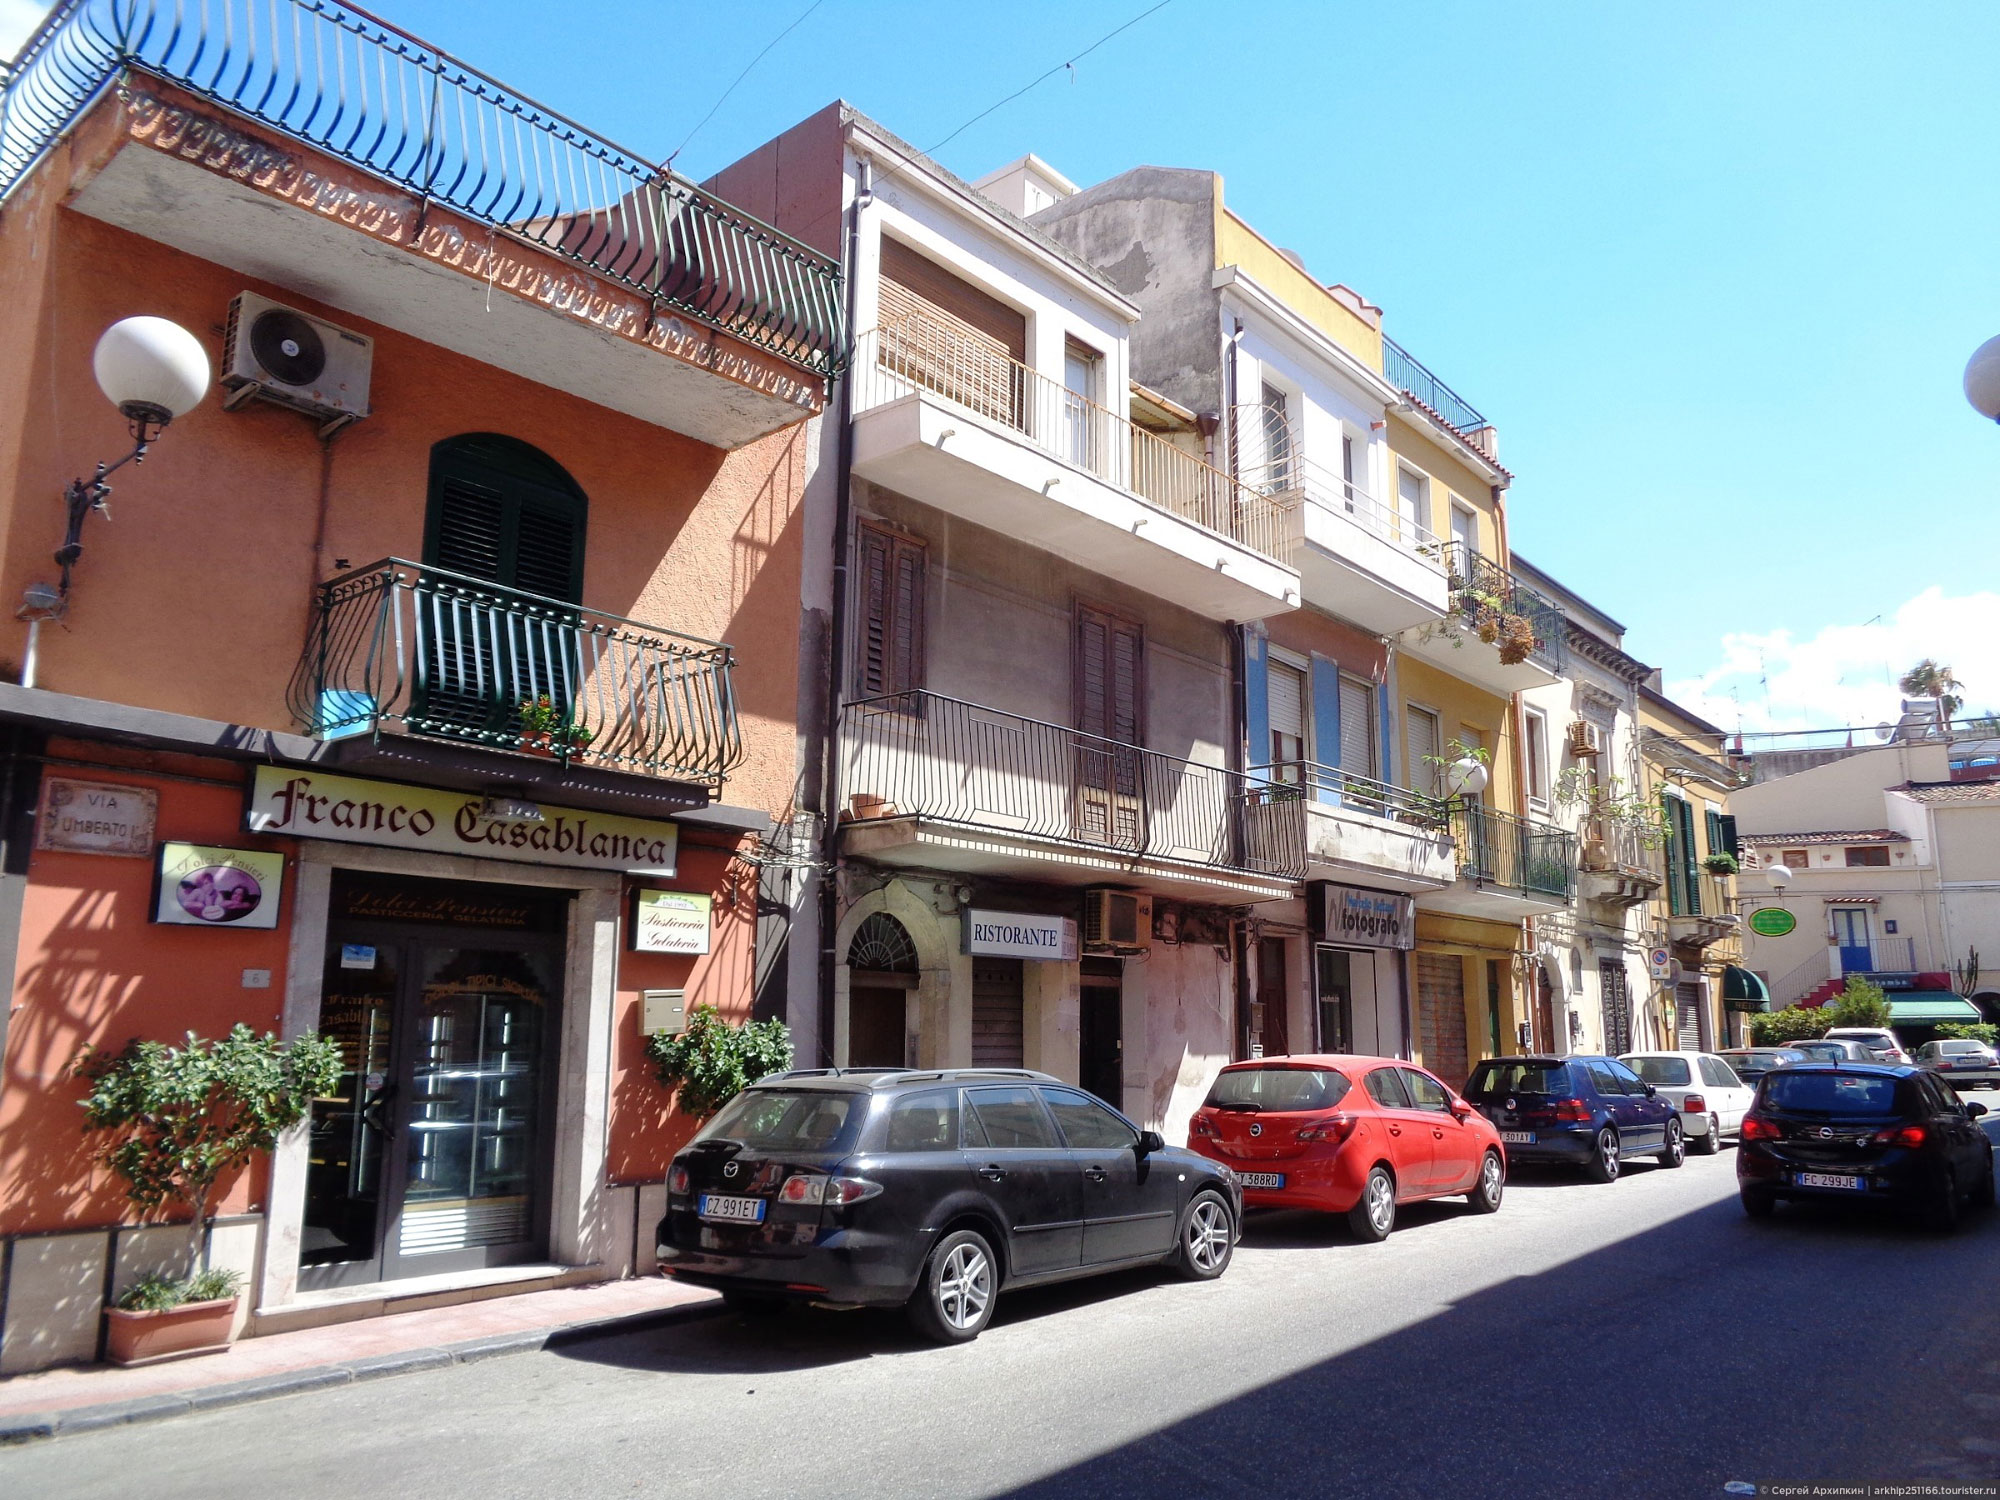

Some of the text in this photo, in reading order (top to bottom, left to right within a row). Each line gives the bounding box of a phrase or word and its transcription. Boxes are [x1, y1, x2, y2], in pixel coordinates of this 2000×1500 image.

[88, 794, 117, 809] VIA
[63, 817, 127, 837] UMBERTO
[266, 777, 666, 864] Franco Casablanca
[218, 852, 268, 882] Pensieri
[348, 906, 526, 926] PASTICCERIA GELATERIA
[641, 911, 704, 930] Pasticceria
[1342, 908, 1399, 938] fotografo
[646, 931, 699, 949] Gelateria
[973, 923, 1058, 947] RISTORANTE
[1248, 1174, 1277, 1186] 388RD
[1803, 1174, 1856, 1188] FC 299JE
[706, 1197, 757, 1218] CZ 991ET
